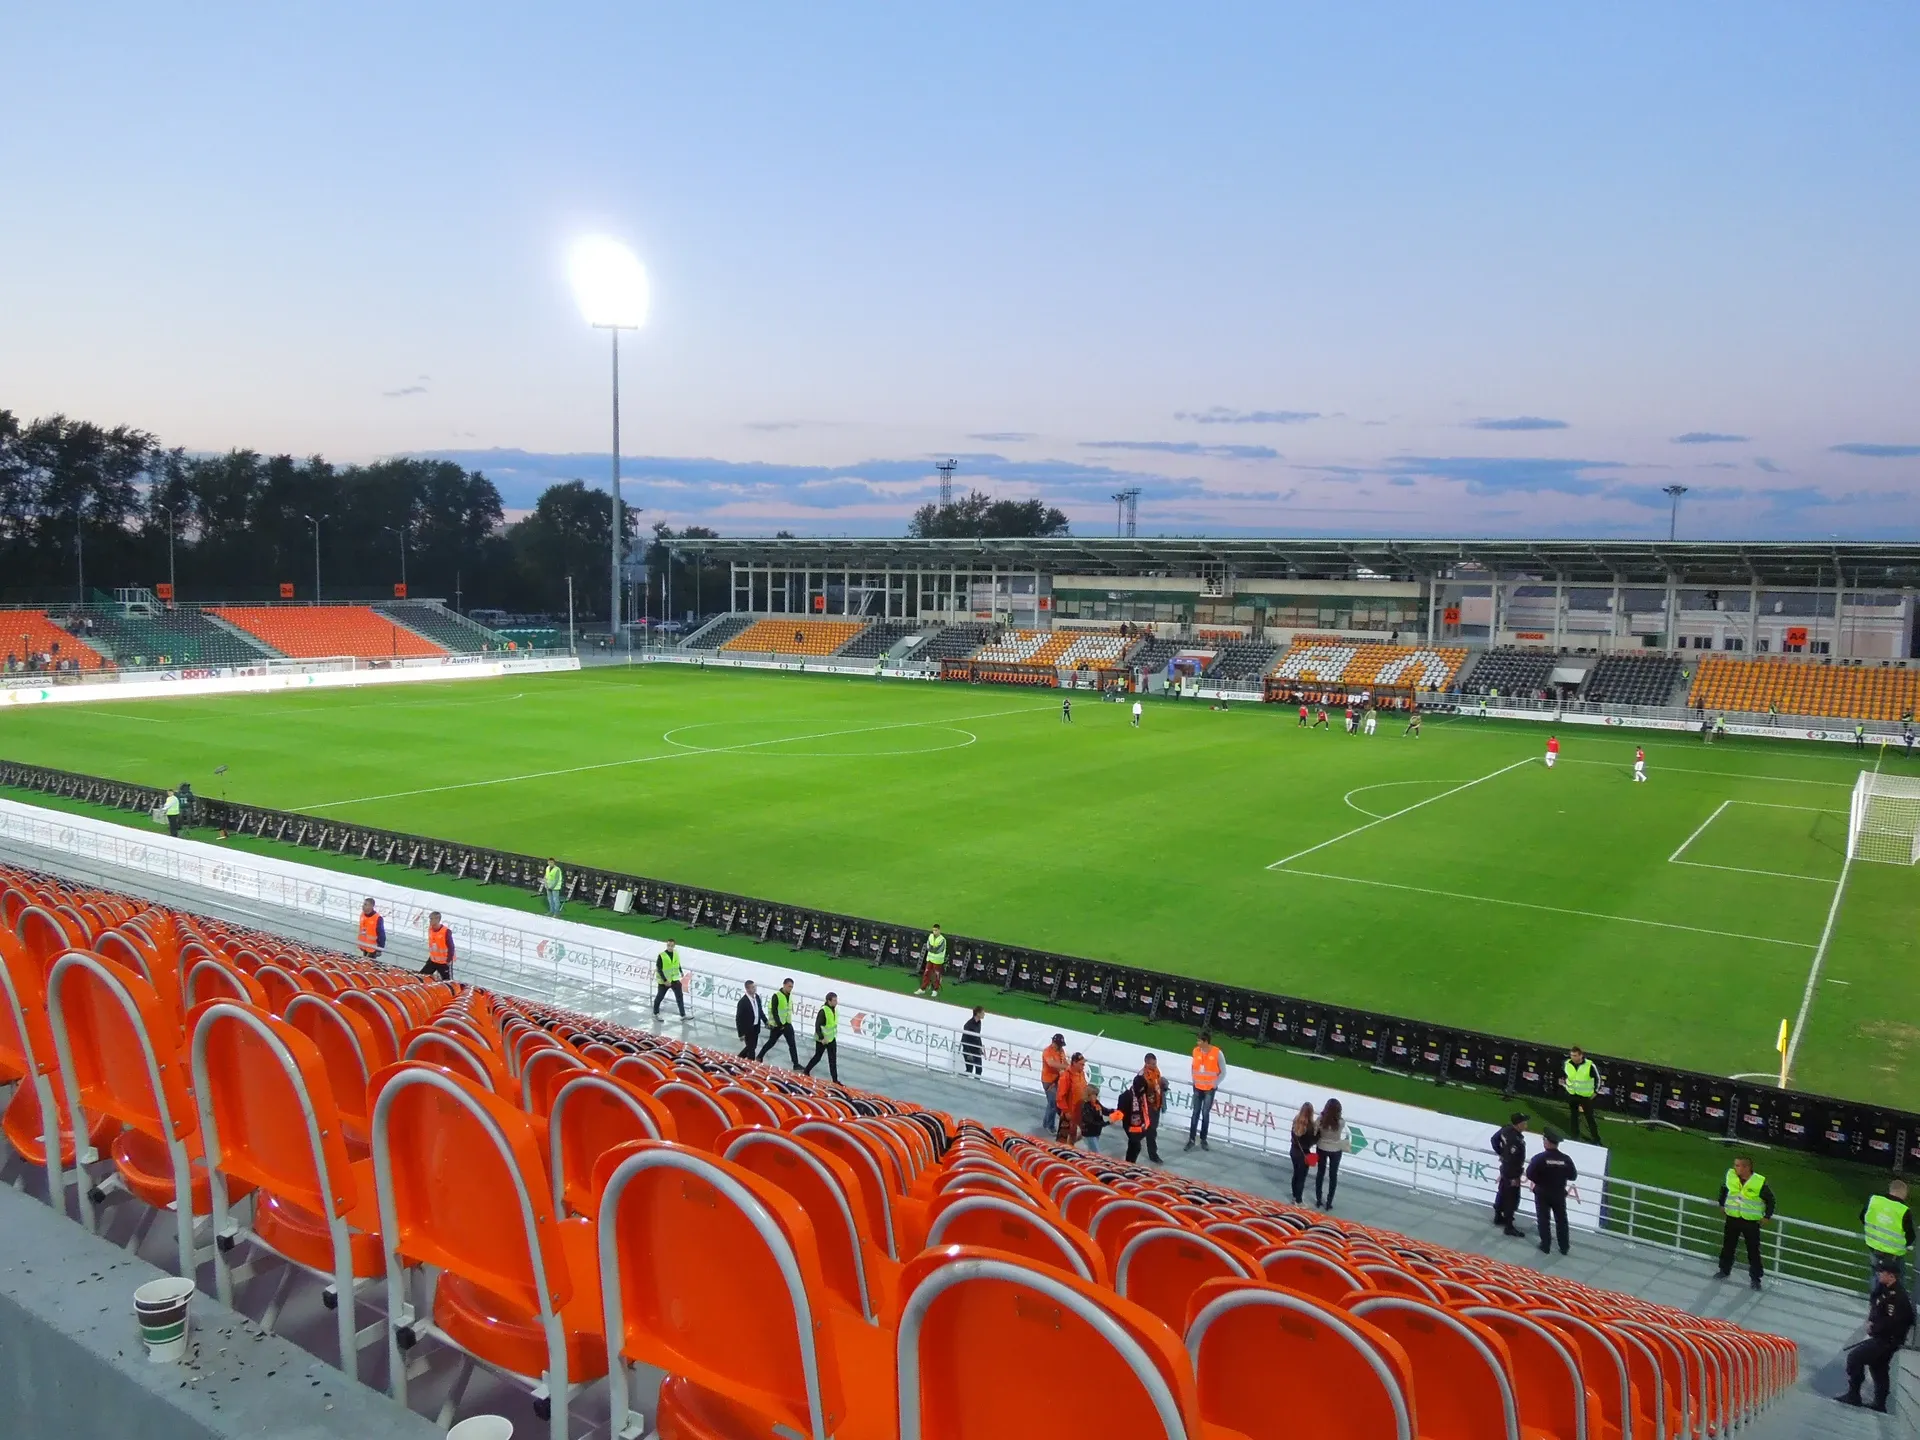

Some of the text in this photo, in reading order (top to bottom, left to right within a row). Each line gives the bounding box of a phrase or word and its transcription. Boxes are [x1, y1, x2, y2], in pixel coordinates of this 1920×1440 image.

[623, 964, 656, 981] АРЕН
[895, 1026, 962, 1055] СКБ-БАН
[1211, 1099, 1276, 1131] АРЕНА
[1373, 1137, 1490, 1183] СКБ-БАНК
